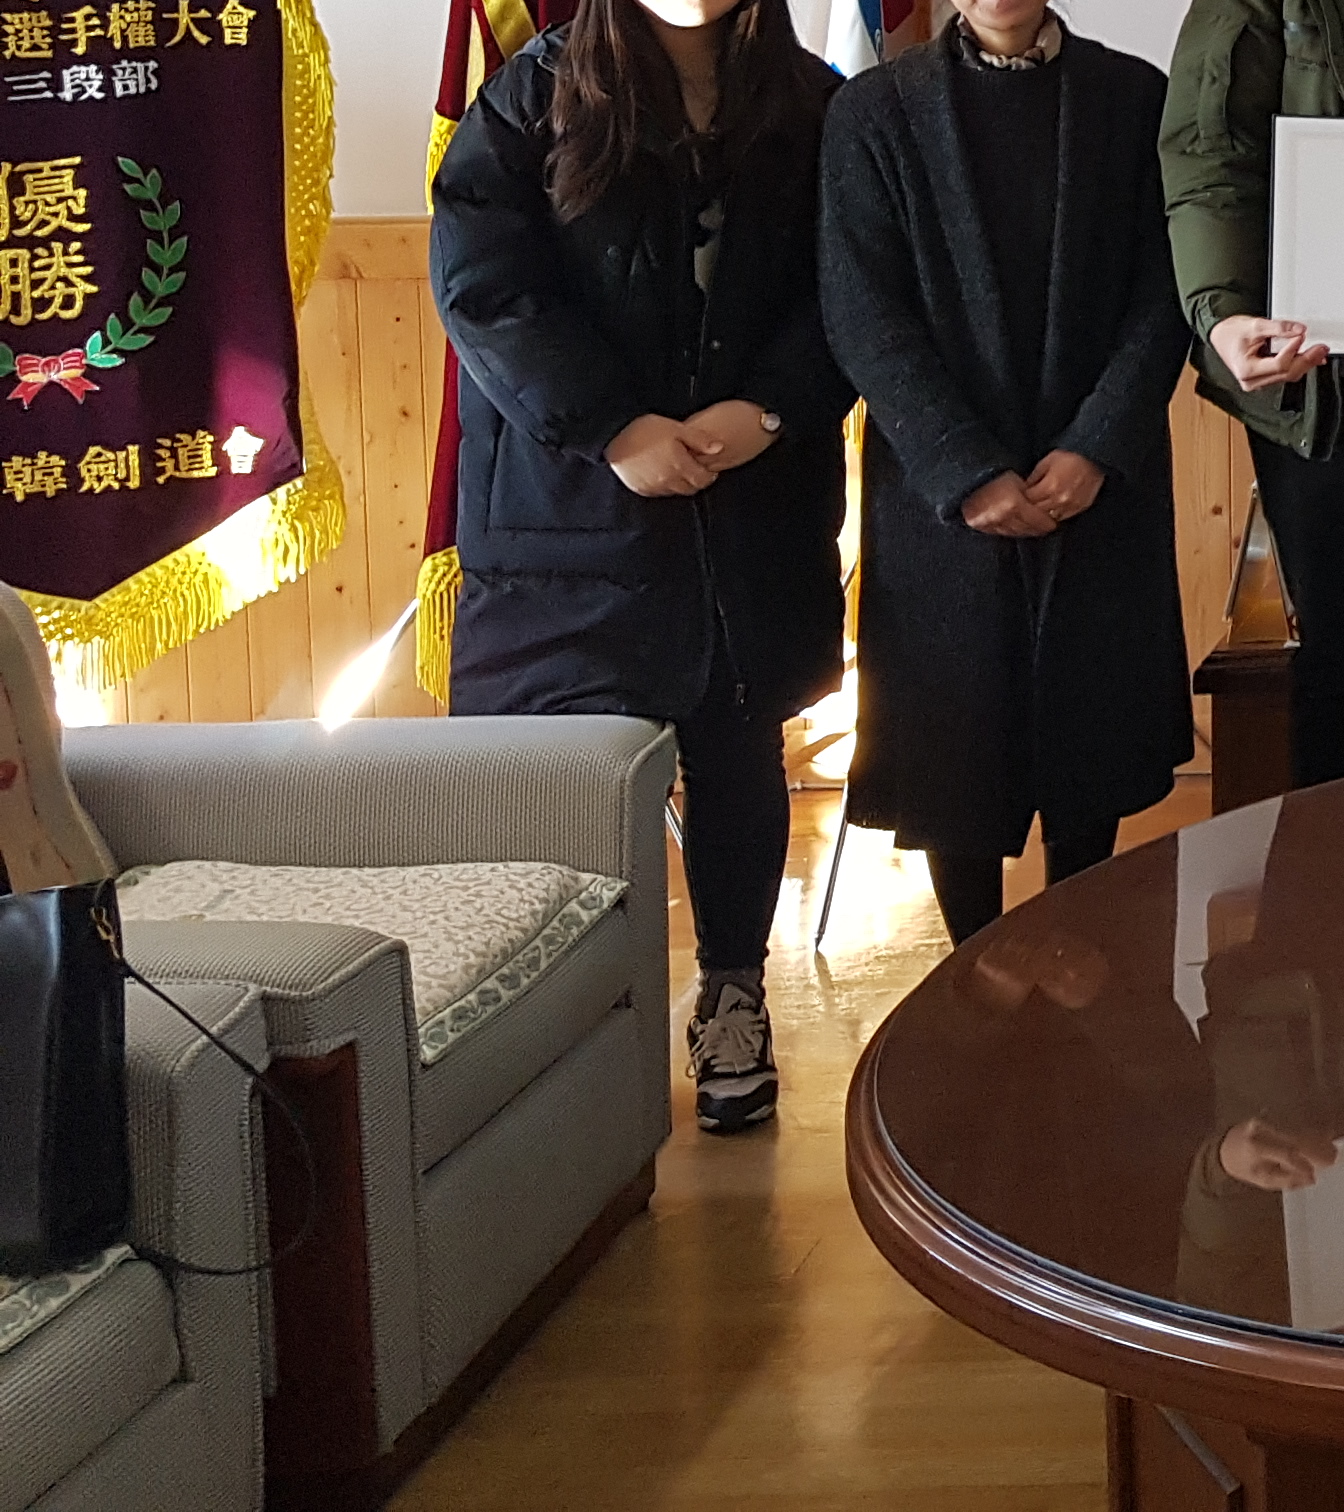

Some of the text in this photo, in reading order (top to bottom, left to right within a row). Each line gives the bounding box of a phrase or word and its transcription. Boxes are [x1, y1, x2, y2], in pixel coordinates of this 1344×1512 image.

[4, 59, 159, 102] 三段部
[2, 425, 266, 503] 韓劍道會
